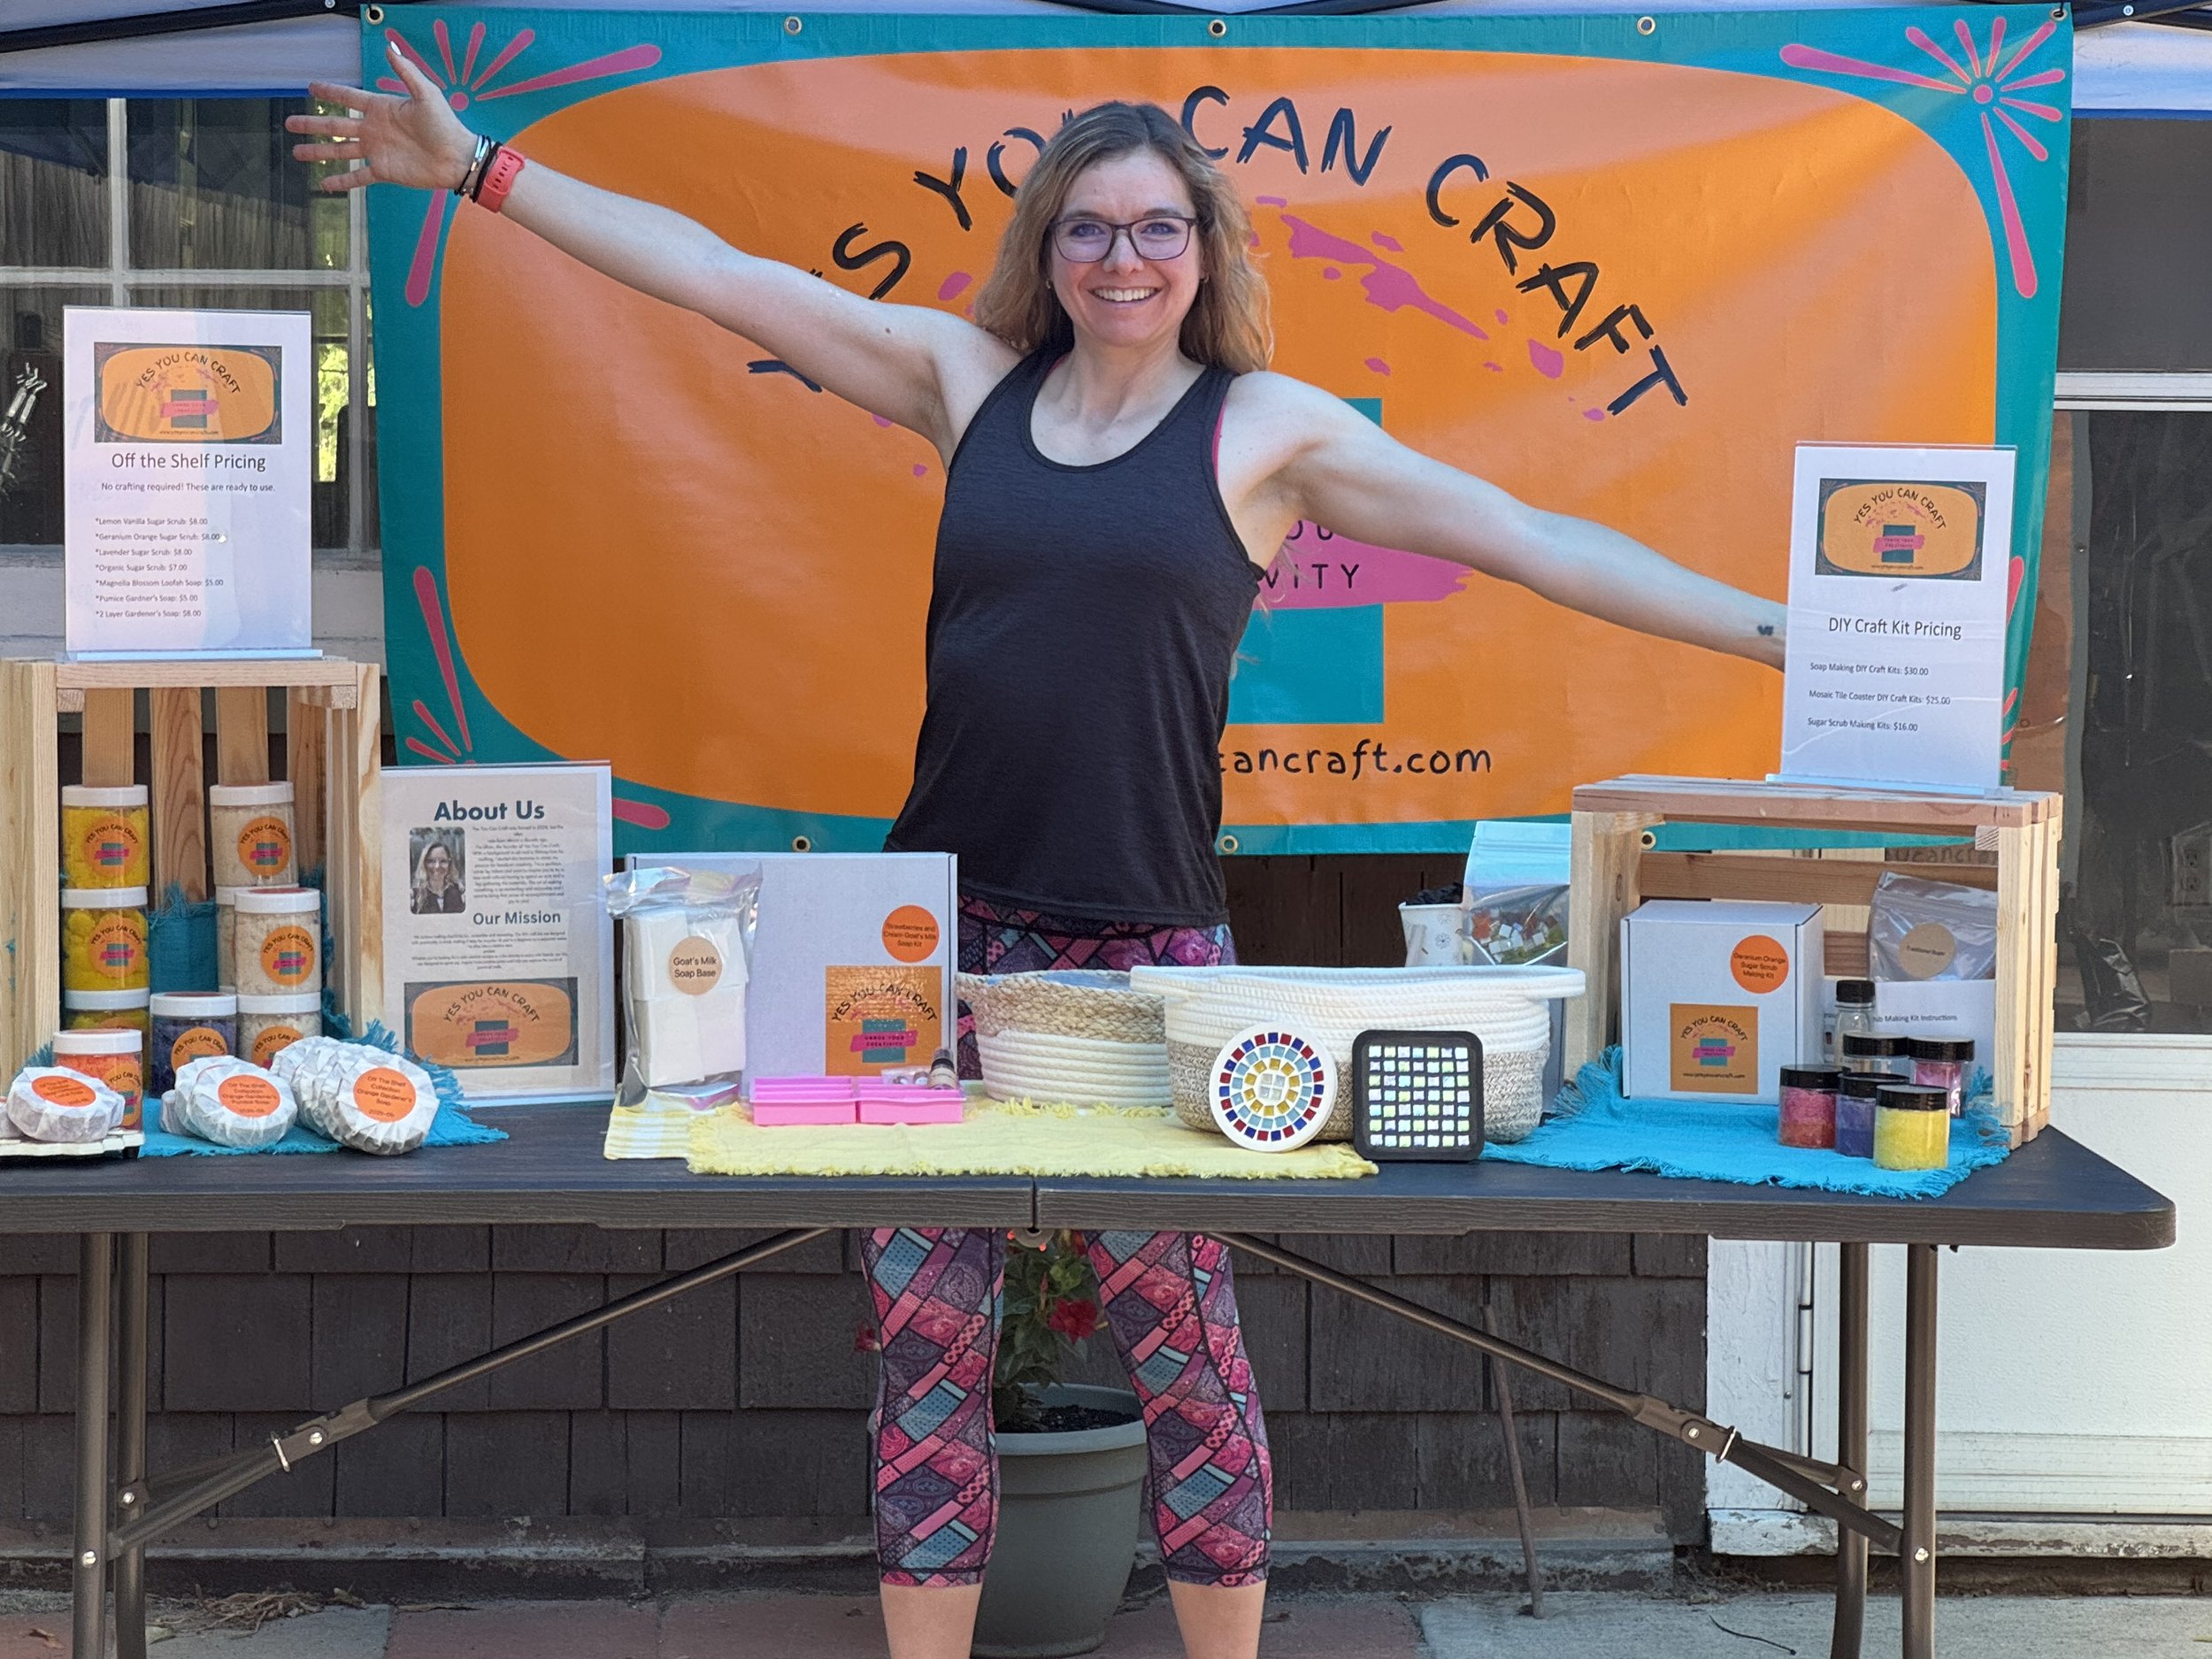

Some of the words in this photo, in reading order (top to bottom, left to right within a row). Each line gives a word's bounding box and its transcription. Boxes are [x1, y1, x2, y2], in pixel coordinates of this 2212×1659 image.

[913, 108, 1074, 232] YO
[1181, 85, 1393, 187] CAN
[1425, 153, 1687, 417] CRAFT
[136, 367, 156, 389] YES
[156, 353, 180, 369] YOU
[185, 351, 208, 365] CAN
[211, 361, 241, 394] CRAFT
[111, 453, 136, 468] Off
[141, 453, 166, 468] the
[171, 454, 210, 468] Shelf
[214, 454, 266, 472] Pricing
[115, 482, 145, 493] crafting
[147, 482, 184, 493] required!
[226, 483, 248, 493] ready
[1853, 503, 1871, 525] YES
[1871, 488, 1893, 505] YOU
[1897, 487, 1919, 501] CAN
[1920, 496, 1947, 530] CRAFT
[147, 518, 165, 526] Sugar
[1829, 617, 1851, 632] DIY
[1855, 618, 1887, 634] Craft
[1892, 620, 1909, 635] Kit
[1915, 621, 1962, 641] Pricing
[1810, 662, 1827, 672] Soap
[1829, 663, 1855, 673] Making
[1869, 664, 1886, 673] Craft
[1887, 665, 1902, 674] Kits:
[1904, 666, 1929, 675] $30.00
[1809, 689, 1833, 699] Mosaic
[1835, 690, 1847, 700] Tile
[1848, 692, 1876, 702] Coaster
[1890, 694, 1907, 703] Craft
[1925, 695, 1951, 705] $25.00
[1808, 718, 1827, 727] Sugar
[1828, 718, 1848, 727] Scrub
[1849, 719, 1875, 730] Making
[1893, 722, 1918, 732] $16.00
[434, 799, 508, 822] About
[516, 801, 545, 819] Us
[472, 912, 501, 925] Our
[504, 910, 561, 925] Mission
[673, 956, 699, 965] Goat's
[1733, 952, 1762, 961] Geranium
[1763, 956, 1786, 964] Orange
[1741, 961, 1758, 970] Sugar
[674, 969, 695, 979] Soap
[696, 968, 717, 977] Base
[1743, 970, 1765, 979] Making
[443, 1002, 461, 1023] YES
[461, 989, 483, 1004] YOU
[488, 987, 510, 998] CAN
[511, 994, 541, 1023] CRAFT
[832, 1000, 851, 1022] YES
[850, 987, 874, 1002] YOU
[879, 983, 903, 996] CAN
[1680, 1025, 1694, 1040] YES
[1692, 1017, 1709, 1027] YOU
[1709, 1015, 1726, 1025] CAN
[1727, 1020, 1748, 1041] CRAFT
[357, 1088, 379, 1097] Orange
